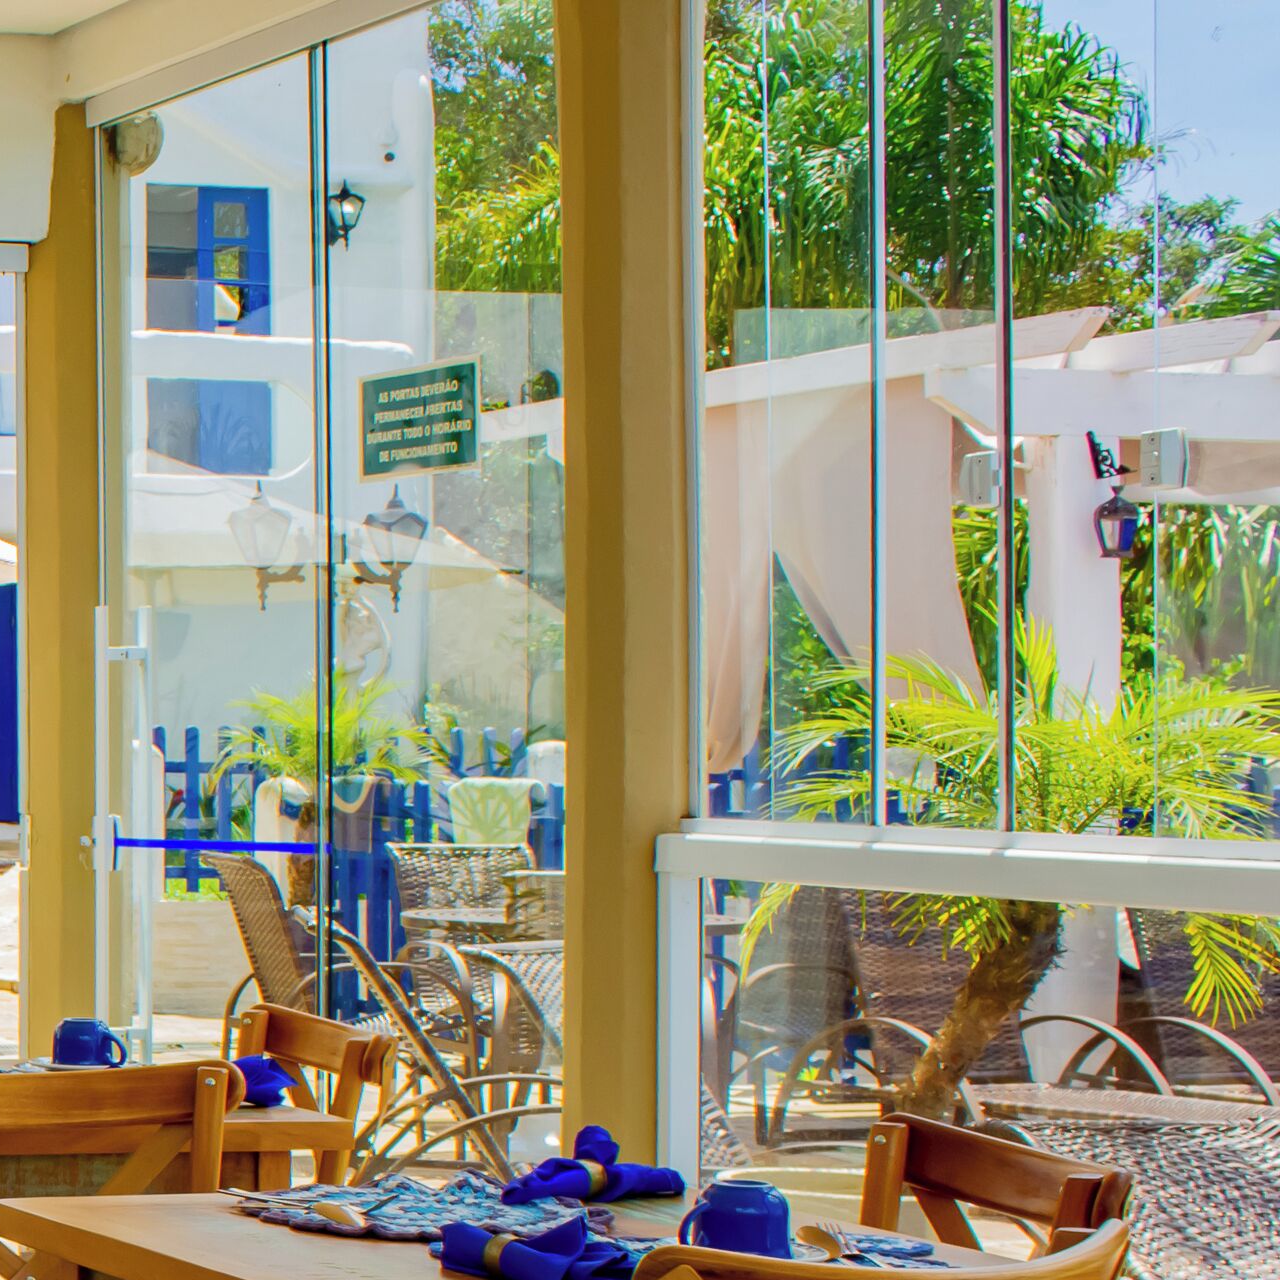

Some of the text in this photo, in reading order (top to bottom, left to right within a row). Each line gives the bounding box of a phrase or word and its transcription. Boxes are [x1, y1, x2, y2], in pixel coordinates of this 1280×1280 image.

[378, 378, 459, 404] AS PORTAS DEVERÃO
[373, 399, 464, 424] PERMANECER ABERTAS
[366, 417, 472, 445] DURANTE TODO O HORÁRIO
[379, 441, 458, 463] DE FUNCIONAMENTO
